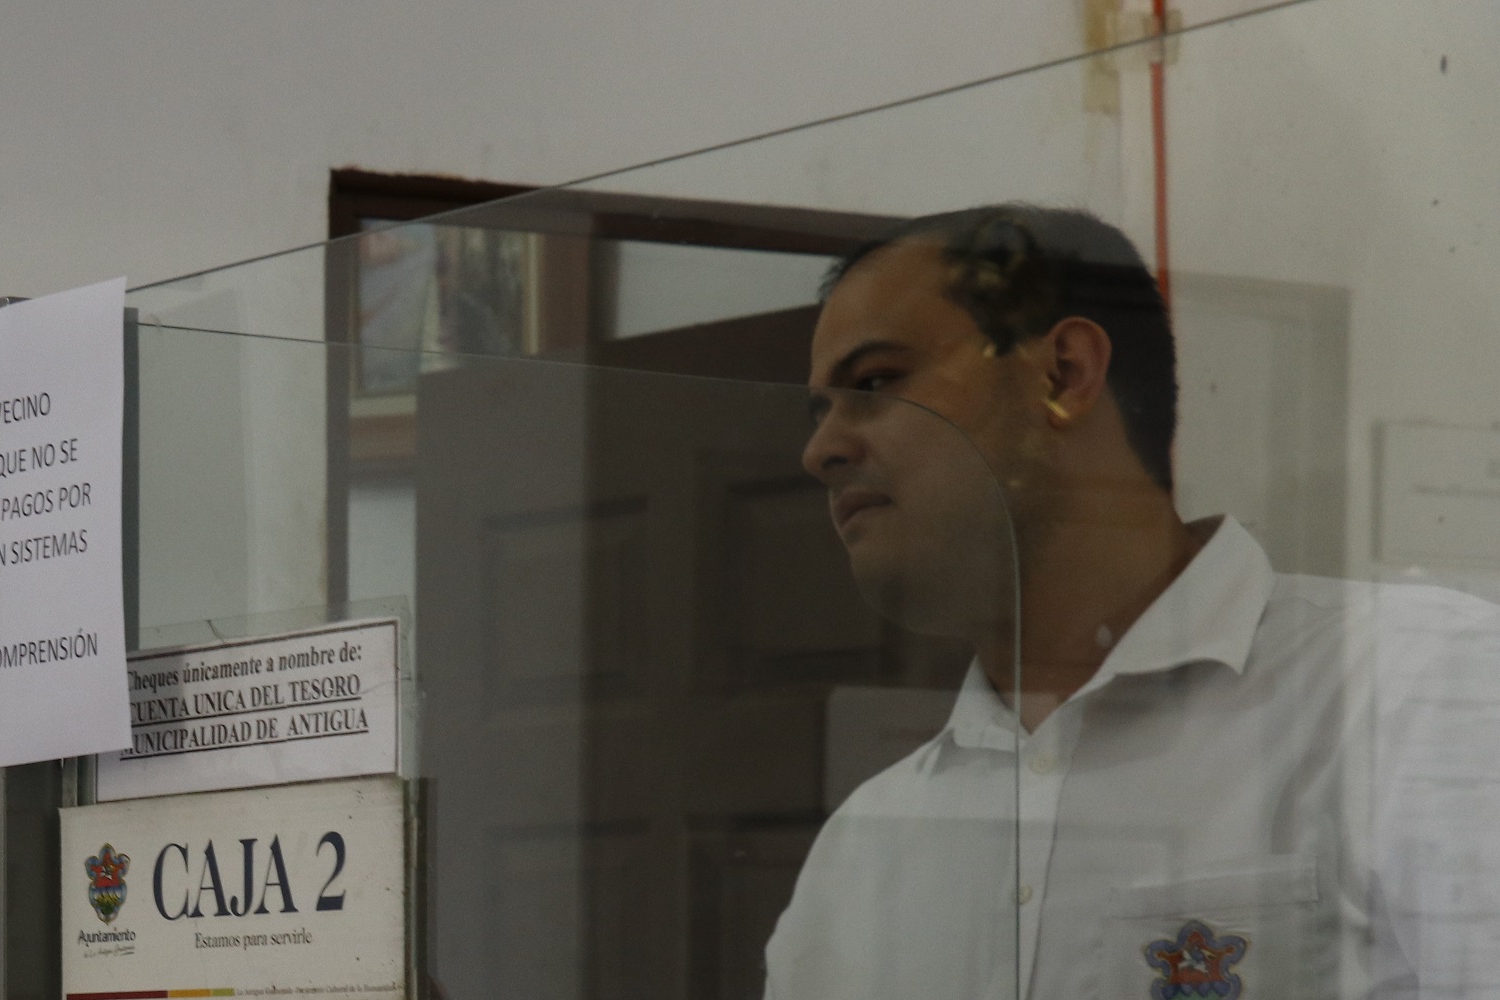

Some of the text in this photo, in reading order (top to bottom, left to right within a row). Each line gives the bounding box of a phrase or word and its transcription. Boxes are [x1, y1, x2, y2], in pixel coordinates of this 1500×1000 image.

[32, 443, 55, 468] NO
[60, 438, 78, 462] SE
[1, 490, 54, 521] PAGOS
[58, 483, 92, 511] POR
[11, 529, 88, 564] SISTEMAS
[183, 657, 262, 684] únicamente
[266, 657, 274, 673] a
[279, 646, 335, 671] nombre
[339, 641, 362, 663] de:
[194, 689, 246, 715] UNICA
[251, 684, 286, 708] DEL
[288, 674, 361, 704] TESORO
[120, 707, 369, 755] UNICIPALIDAD DE ANTIGUA
[153, 831, 347, 921] CAJA 2
[195, 927, 312, 950] Estamos para servirle
